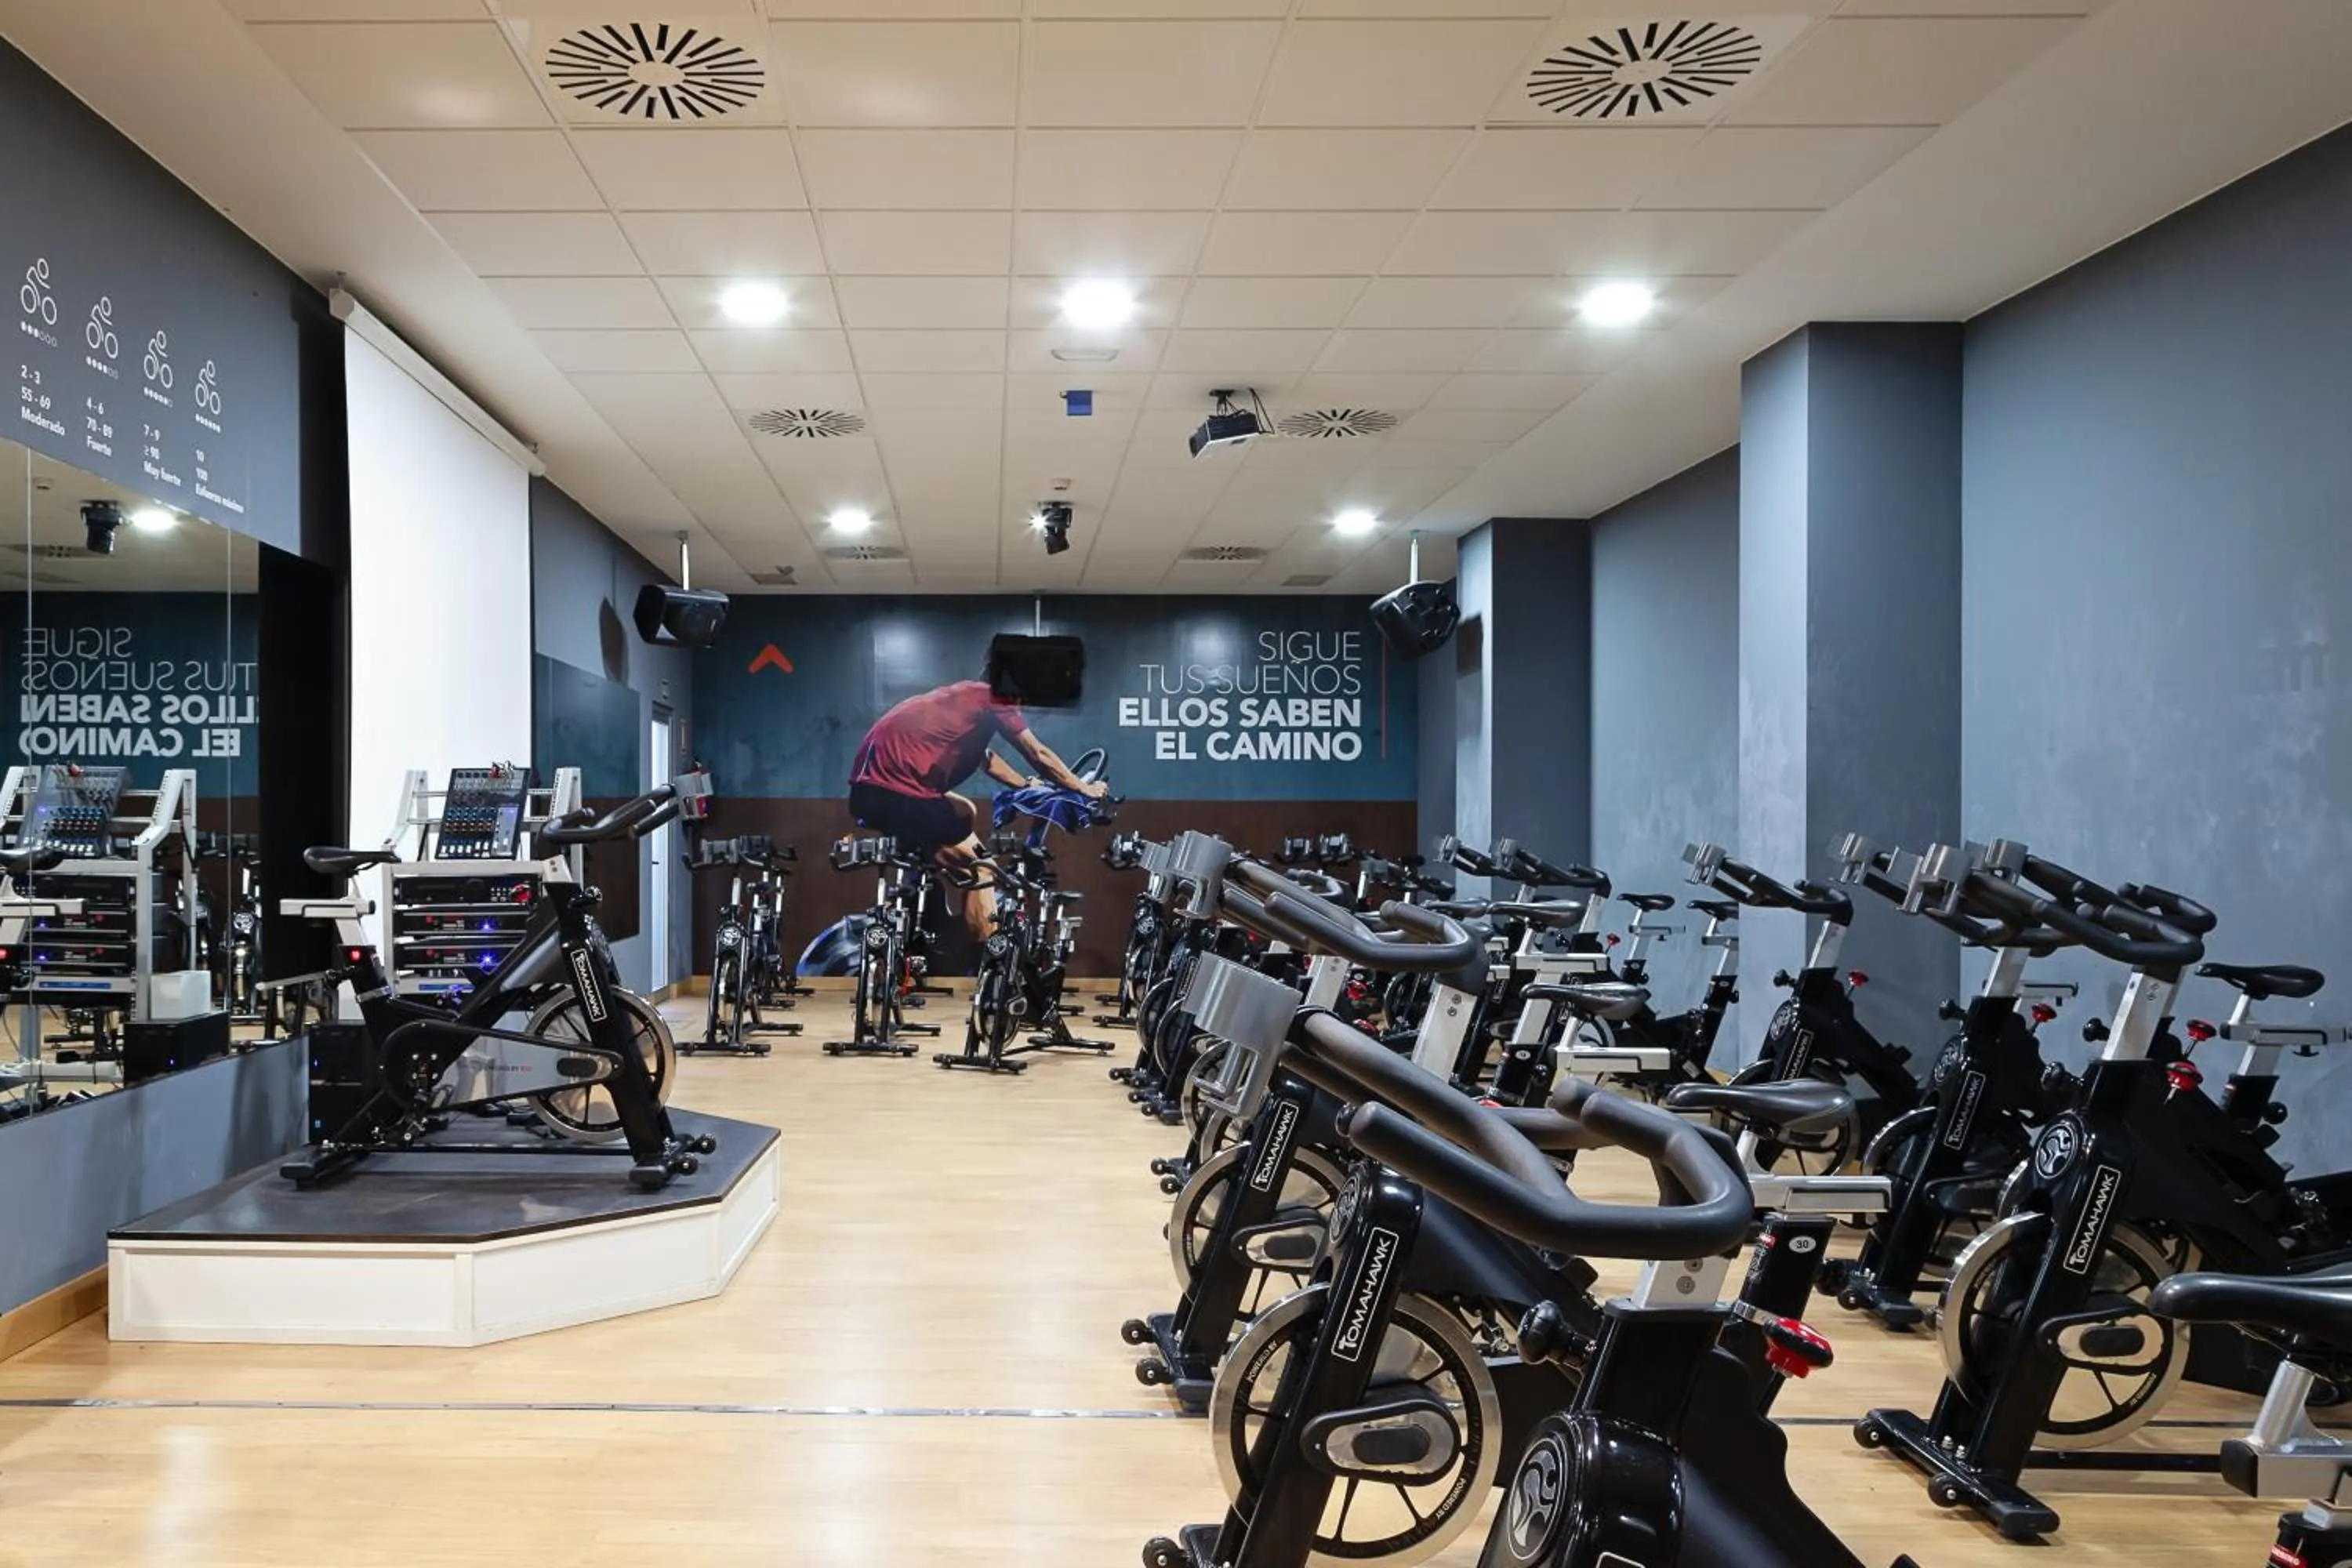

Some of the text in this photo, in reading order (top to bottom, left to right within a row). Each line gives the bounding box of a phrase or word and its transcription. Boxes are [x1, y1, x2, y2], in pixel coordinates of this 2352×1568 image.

[21, 406, 65, 436] Moderado
[1258, 630, 1362, 662] SIGUE
[1139, 664, 1205, 695] TUS
[1119, 697, 1362, 728] ELLOS SABEN
[1155, 731, 1363, 761] EL CAMINO
[1254, 1108, 1294, 1183] TOMAHAWK
[2069, 1174, 2115, 1265] TOMAHAWK
[1796, 1240, 1809, 1249] 30
[1338, 1237, 1392, 1350] TOMAHAWK
